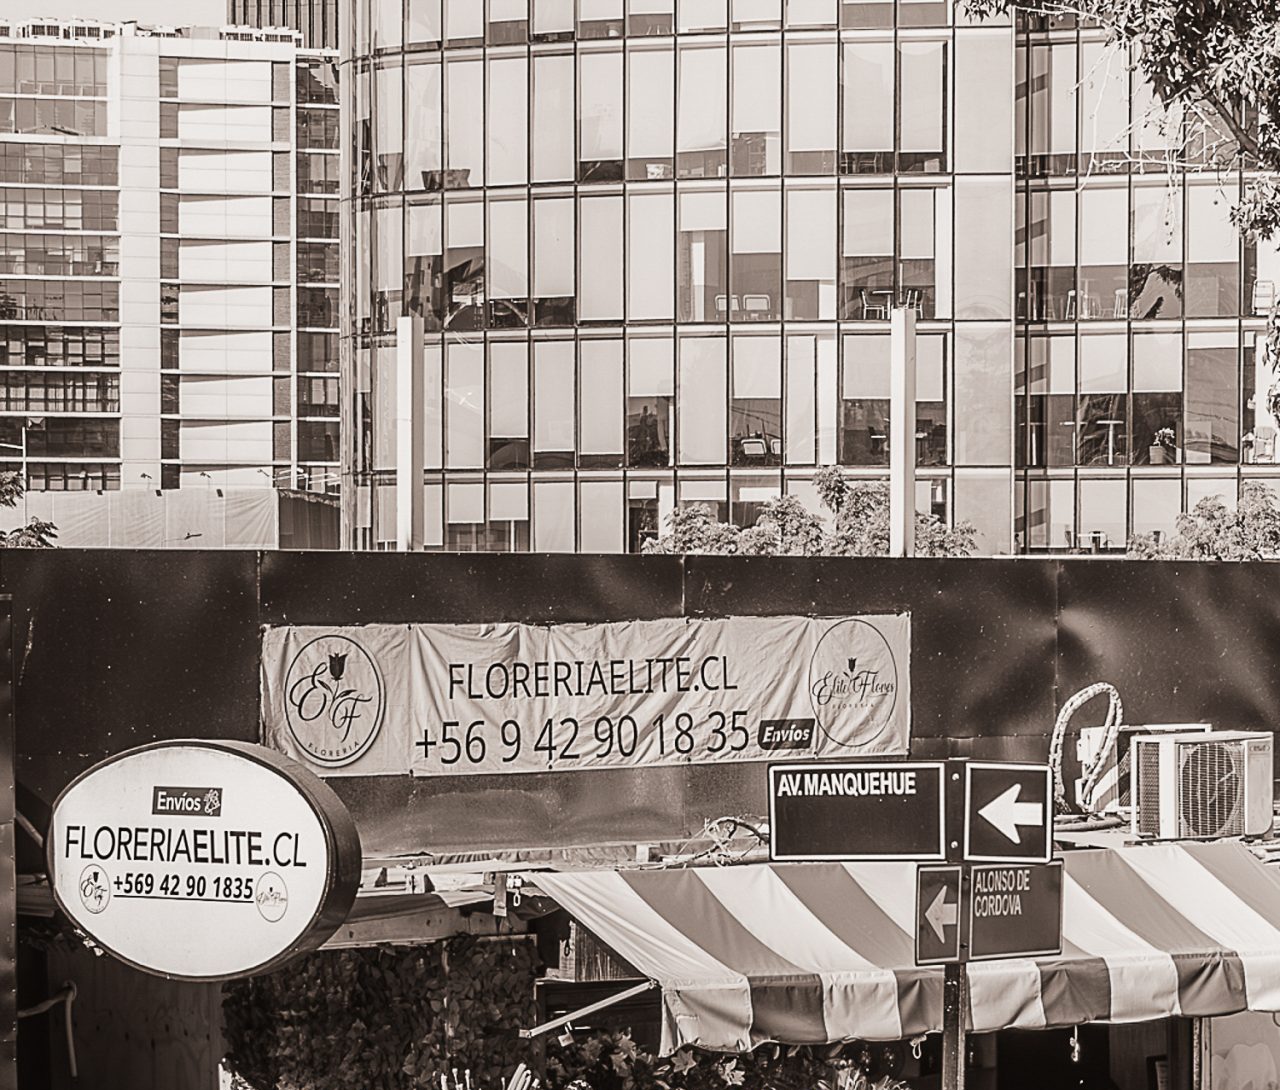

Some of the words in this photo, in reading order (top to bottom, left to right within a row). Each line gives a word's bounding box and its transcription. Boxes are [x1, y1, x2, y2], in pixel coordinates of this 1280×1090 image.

[448, 655, 738, 700] FLORERIAELITE.CL
[416, 720, 486, 764] +56
[501, 719, 521, 763] 9
[534, 717, 580, 761] 42
[594, 714, 638, 759] 90
[655, 712, 695, 755] 18
[707, 710, 749, 753] 35
[762, 724, 810, 743] Envíos
[307, 742, 360, 757] FLORERIA
[157, 791, 201, 811] Envíos
[65, 825, 307, 867] FLORERIAELITE.CL
[114, 873, 154, 895] +569
[159, 874, 180, 896] 42
[186, 875, 207, 897] 90
[213, 877, 254, 899] 1835
[975, 870, 1015, 893] ALONSO
[1016, 869, 1030, 891] DE
[974, 894, 1022, 917] CORDOVA
